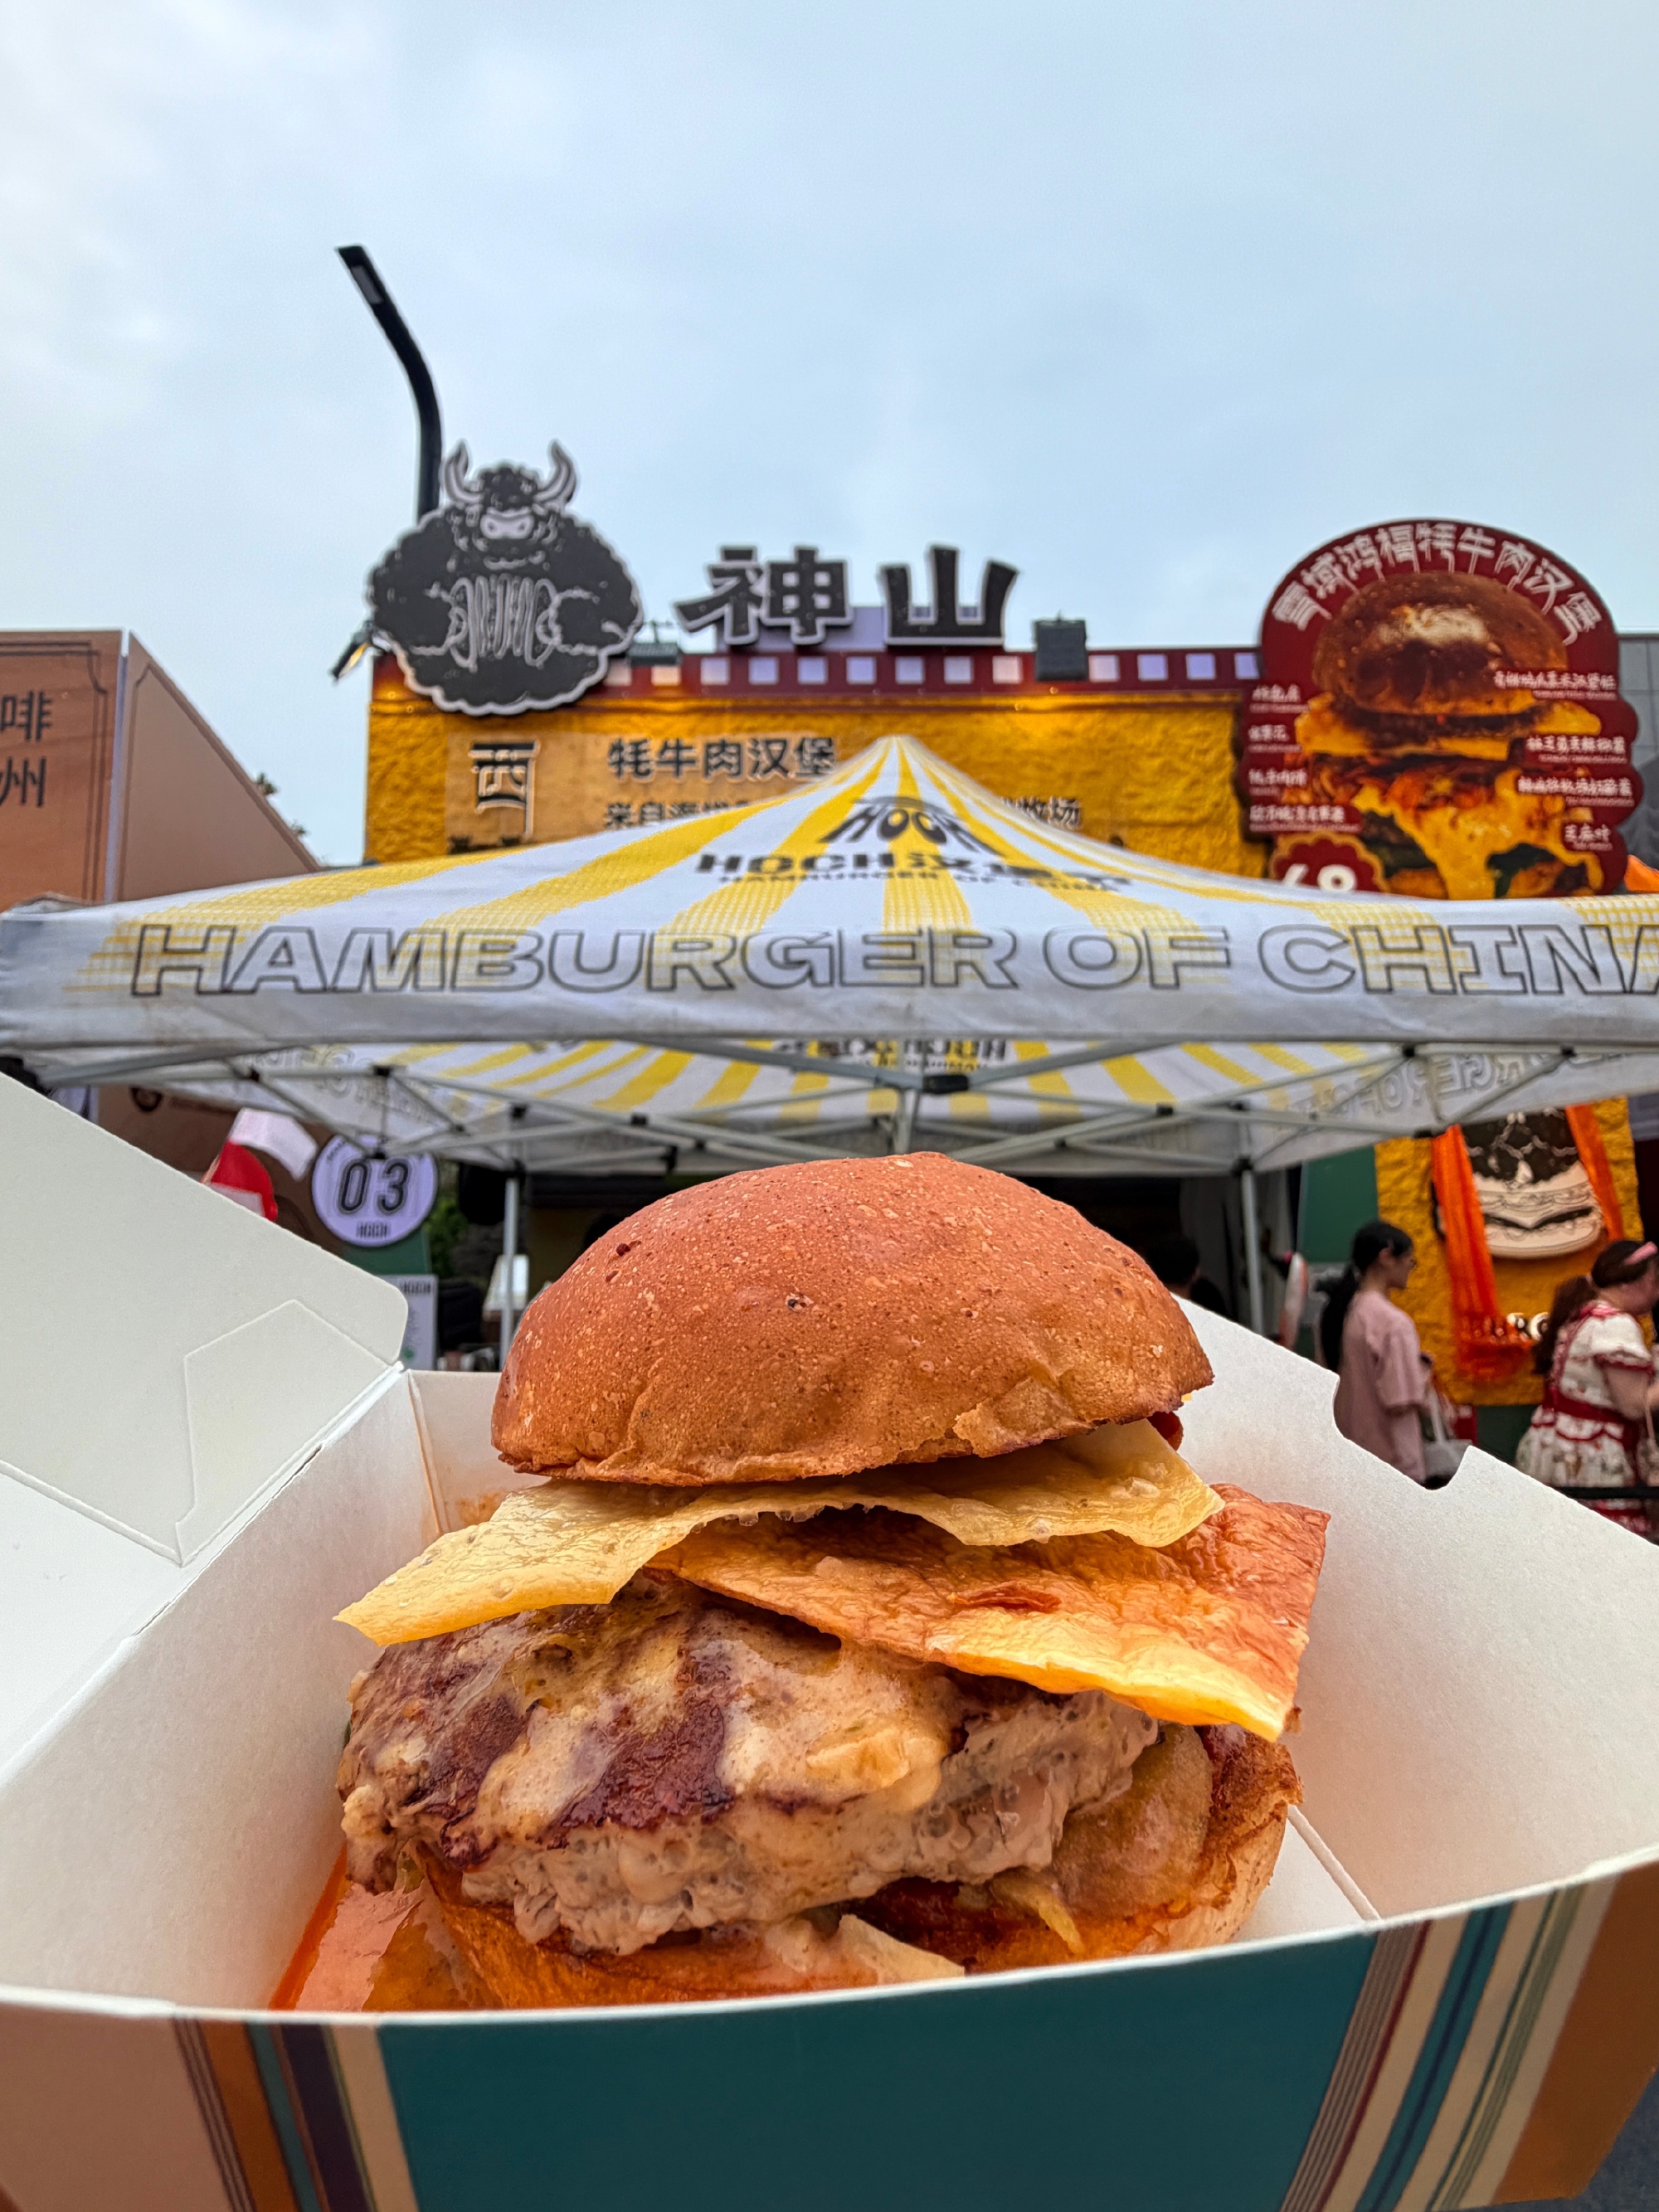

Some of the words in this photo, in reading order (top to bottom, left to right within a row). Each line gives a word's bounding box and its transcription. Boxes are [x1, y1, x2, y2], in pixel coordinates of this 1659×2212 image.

[674, 544, 1019, 645] 神山
[607, 737, 836, 780] 牦牛肉汉堡
[131, 922, 1019, 996] HAMBURGER
[1043, 924, 1232, 989] OF
[338, 1159, 411, 1216] 03
